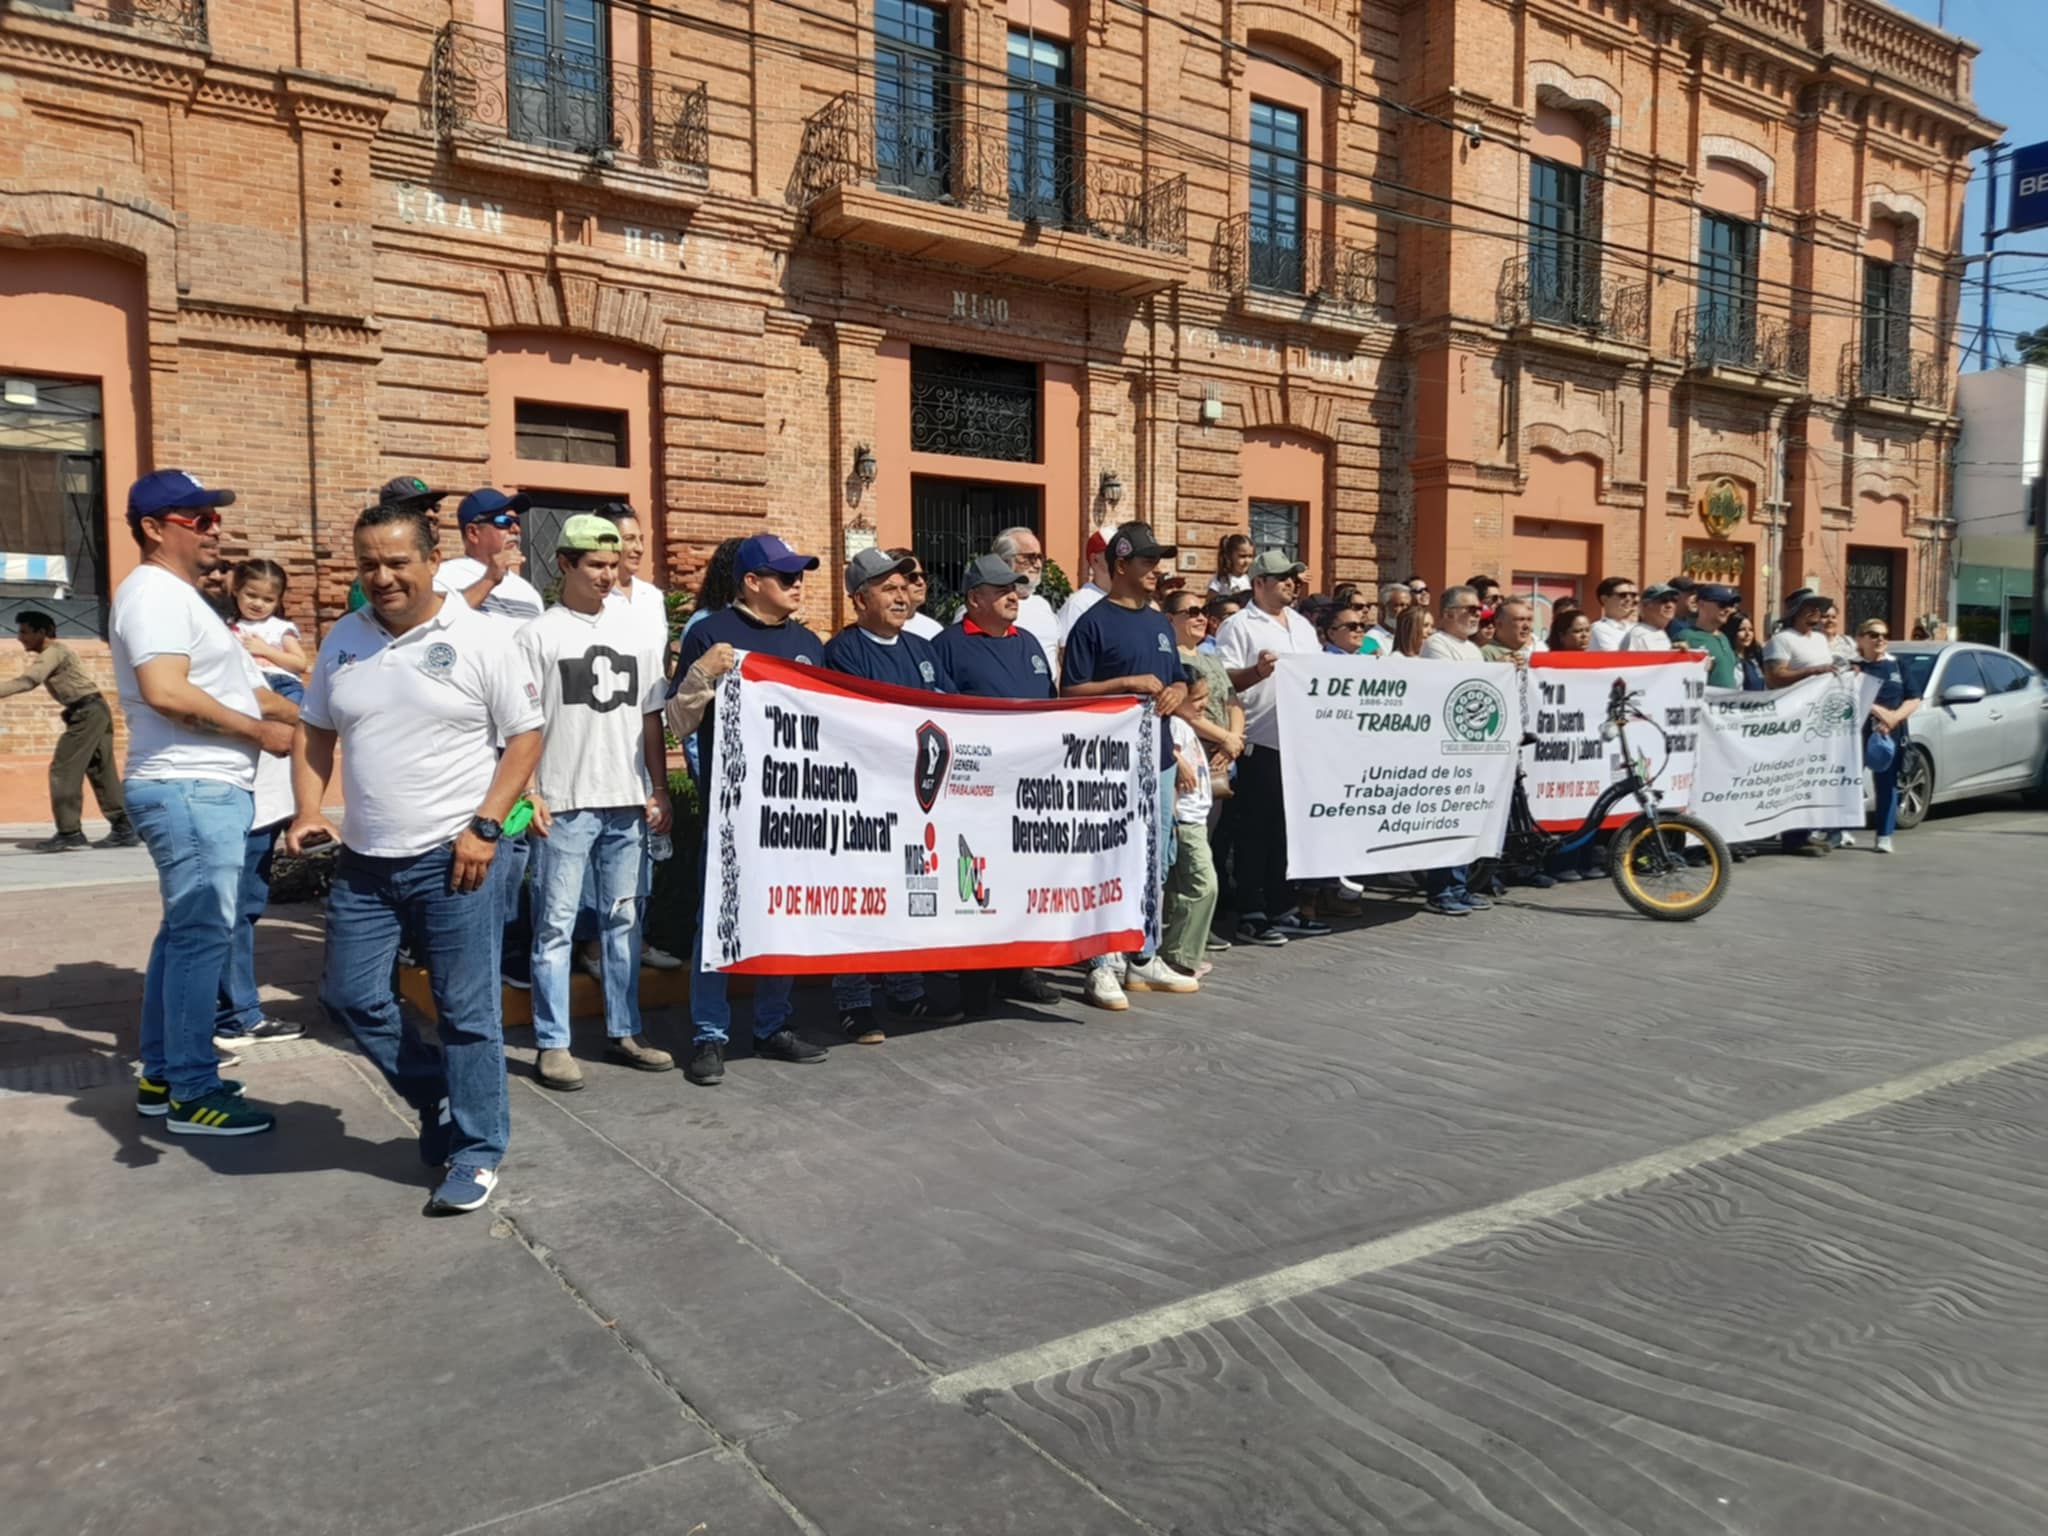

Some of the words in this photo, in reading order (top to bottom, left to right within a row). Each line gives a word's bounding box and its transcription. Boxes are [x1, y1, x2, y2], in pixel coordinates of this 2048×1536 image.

[397, 187, 504, 234] GRAN
[1307, 678, 1319, 696] 1
[1327, 678, 1354, 696] DE
[1358, 678, 1407, 697] MAYO
[801, 714, 819, 752] un
[1315, 708, 1333, 719] DÍA
[1336, 709, 1354, 719] DEL
[1356, 712, 1431, 732] TRABAJO
[1741, 719, 1801, 737] TRABAJO
[1085, 735, 1099, 770] el
[1100, 735, 1130, 775] pleno
[762, 754, 799, 799] Gran
[802, 757, 858, 803] Acuerdo
[1362, 766, 1427, 783] ¡Unidad
[1431, 765, 1450, 779] de
[1453, 766, 1473, 778] los
[1806, 767, 1825, 775] en
[1016, 774, 1064, 815] respeto
[1067, 779, 1074, 811] a
[1077, 777, 1127, 812] nuestros
[1344, 784, 1451, 800] Trabajadores
[1455, 785, 1470, 795] en
[1474, 782, 1485, 794] la
[1701, 790, 1763, 803] Defensa
[1767, 784, 1781, 797] de
[1309, 802, 1386, 818] Defensa
[1392, 801, 1411, 814] de
[1416, 800, 1436, 813] los
[760, 804, 827, 850] Nacional
[830, 814, 839, 856] y
[1012, 815, 1069, 853] Derechos
[1378, 817, 1459, 833] Adquiridos
[786, 885, 802, 915] DE
[805, 885, 839, 915] MAYO
[842, 886, 857, 915] DE
[861, 887, 887, 915] 2025
[1038, 888, 1050, 913] DE
[1050, 886, 1080, 913] MAYO
[1082, 886, 1096, 911] DE
[1099, 877, 1123, 907] 2025
